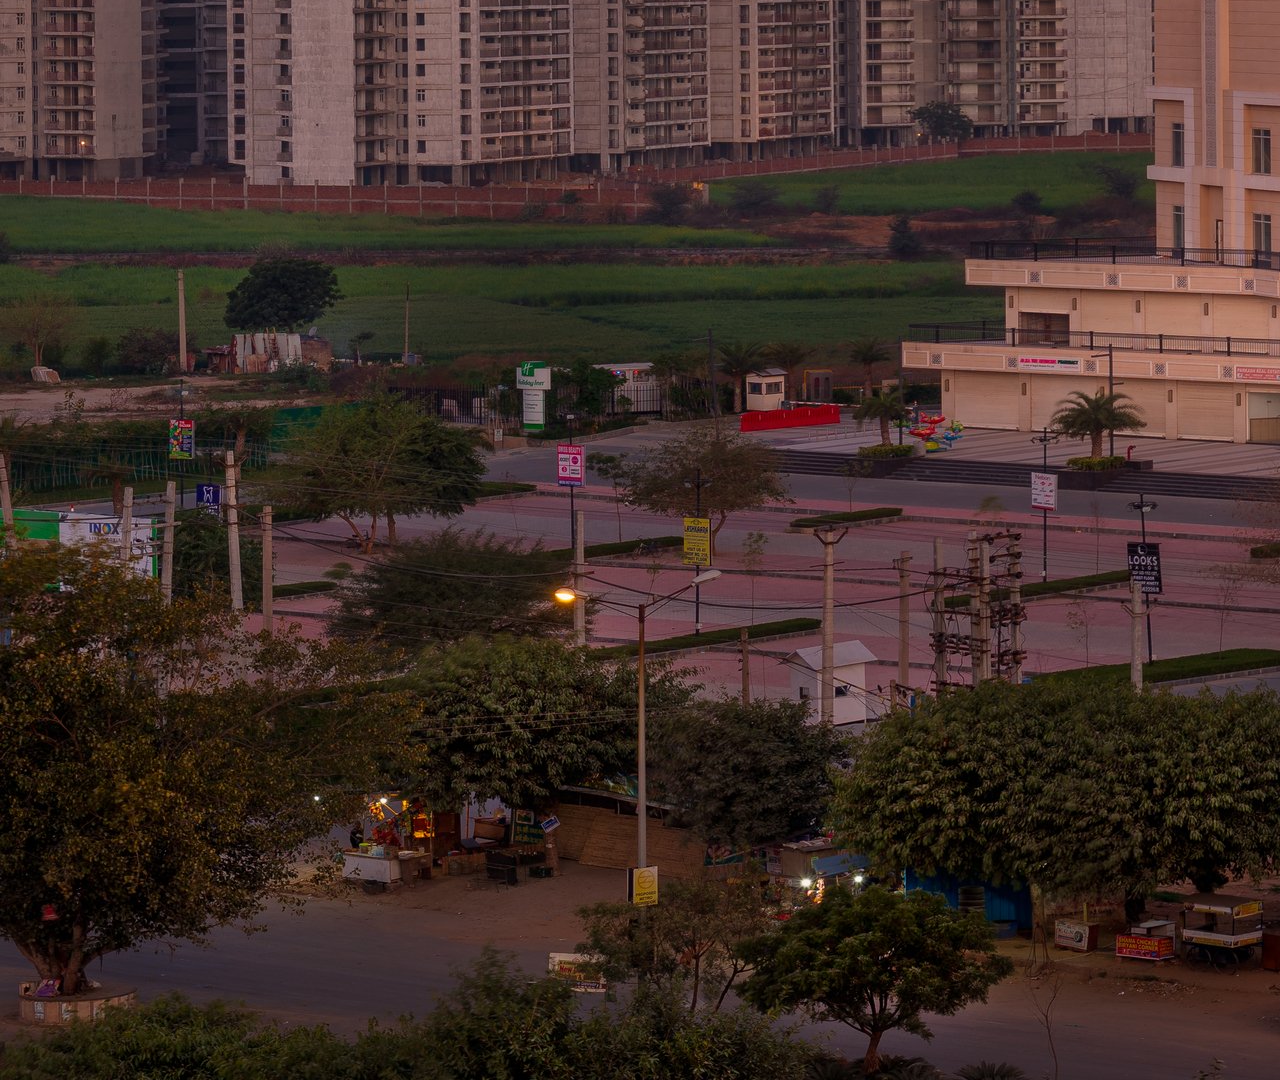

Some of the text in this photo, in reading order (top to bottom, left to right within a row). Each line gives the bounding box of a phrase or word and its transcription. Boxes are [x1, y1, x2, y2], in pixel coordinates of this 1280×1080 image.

[518, 379, 534, 387] Holiday
[568, 446, 581, 454] BEAUTY
[88, 522, 120, 536] INOX
[1128, 556, 1158, 566] LOOKS
[1136, 938, 1159, 946] CHICKEN
[1138, 944, 1159, 952] CORNER
